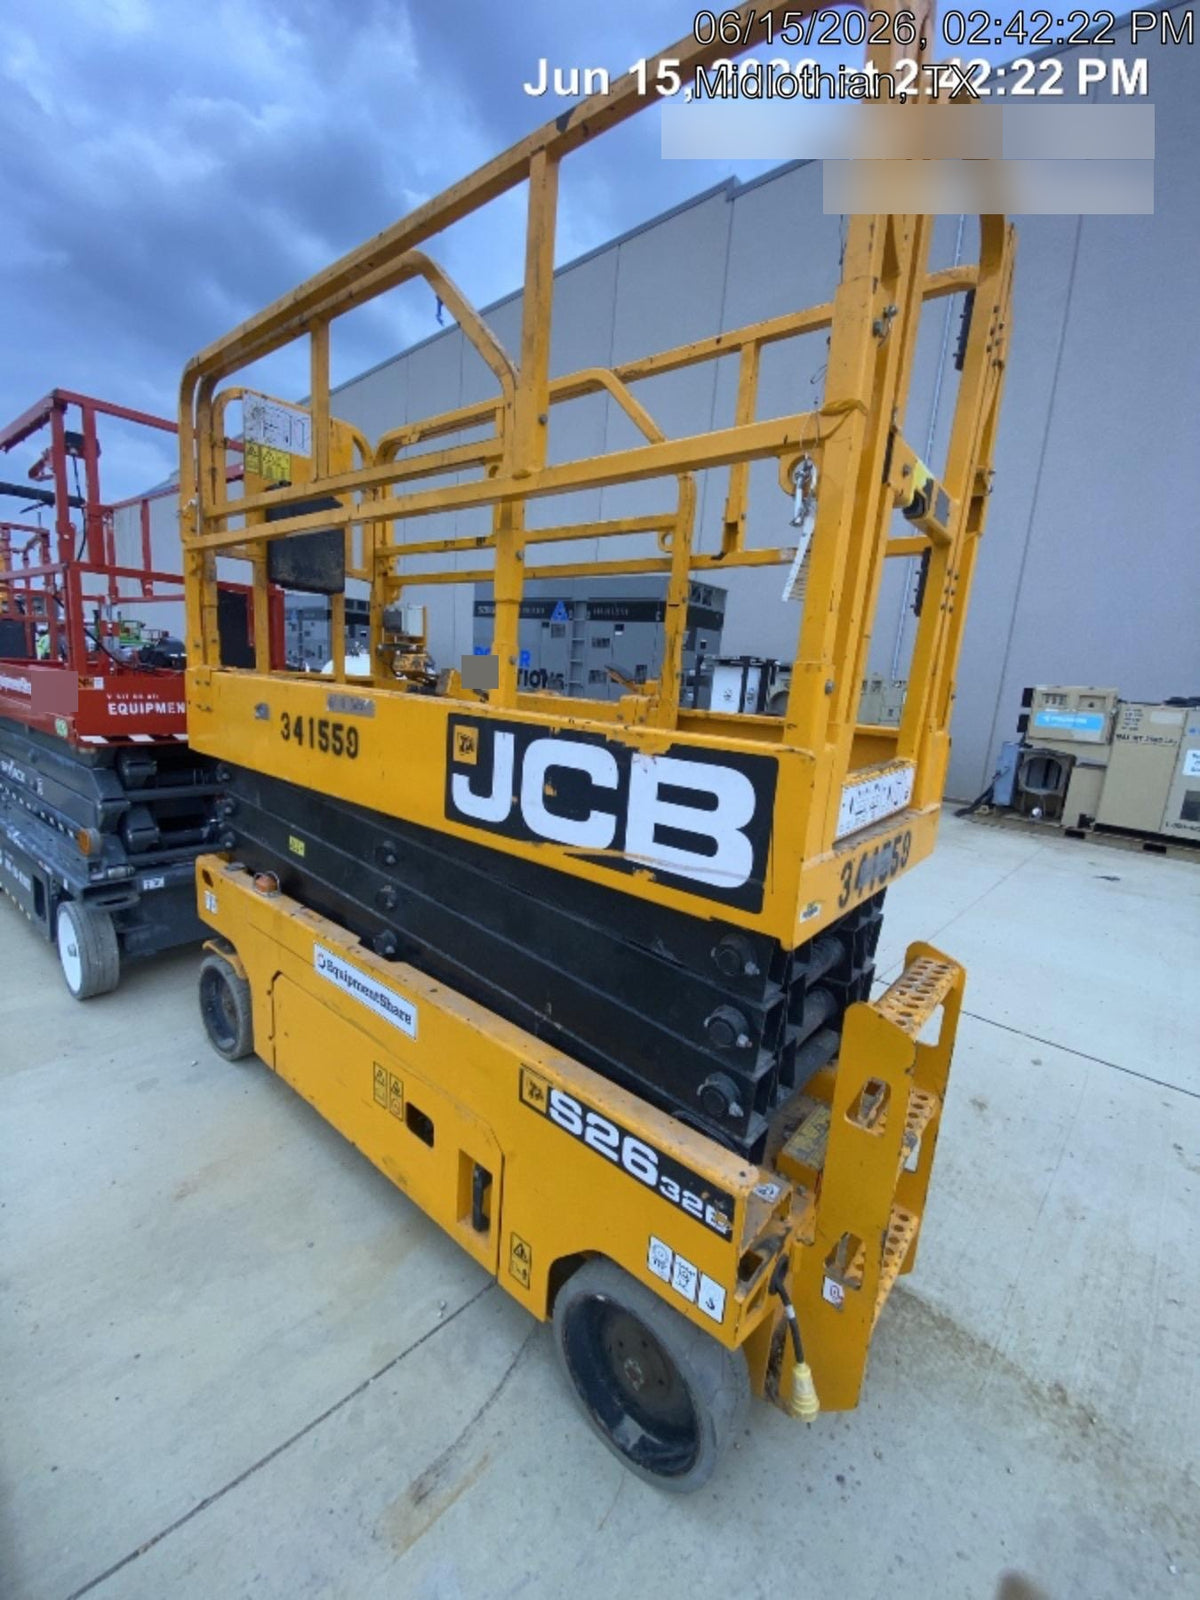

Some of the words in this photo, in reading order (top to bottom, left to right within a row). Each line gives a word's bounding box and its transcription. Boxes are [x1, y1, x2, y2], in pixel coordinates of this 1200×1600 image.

[280, 711, 359, 759] 341559
[451, 730, 756, 888] JCB
[326, 959, 412, 1026] EquipmentShare
